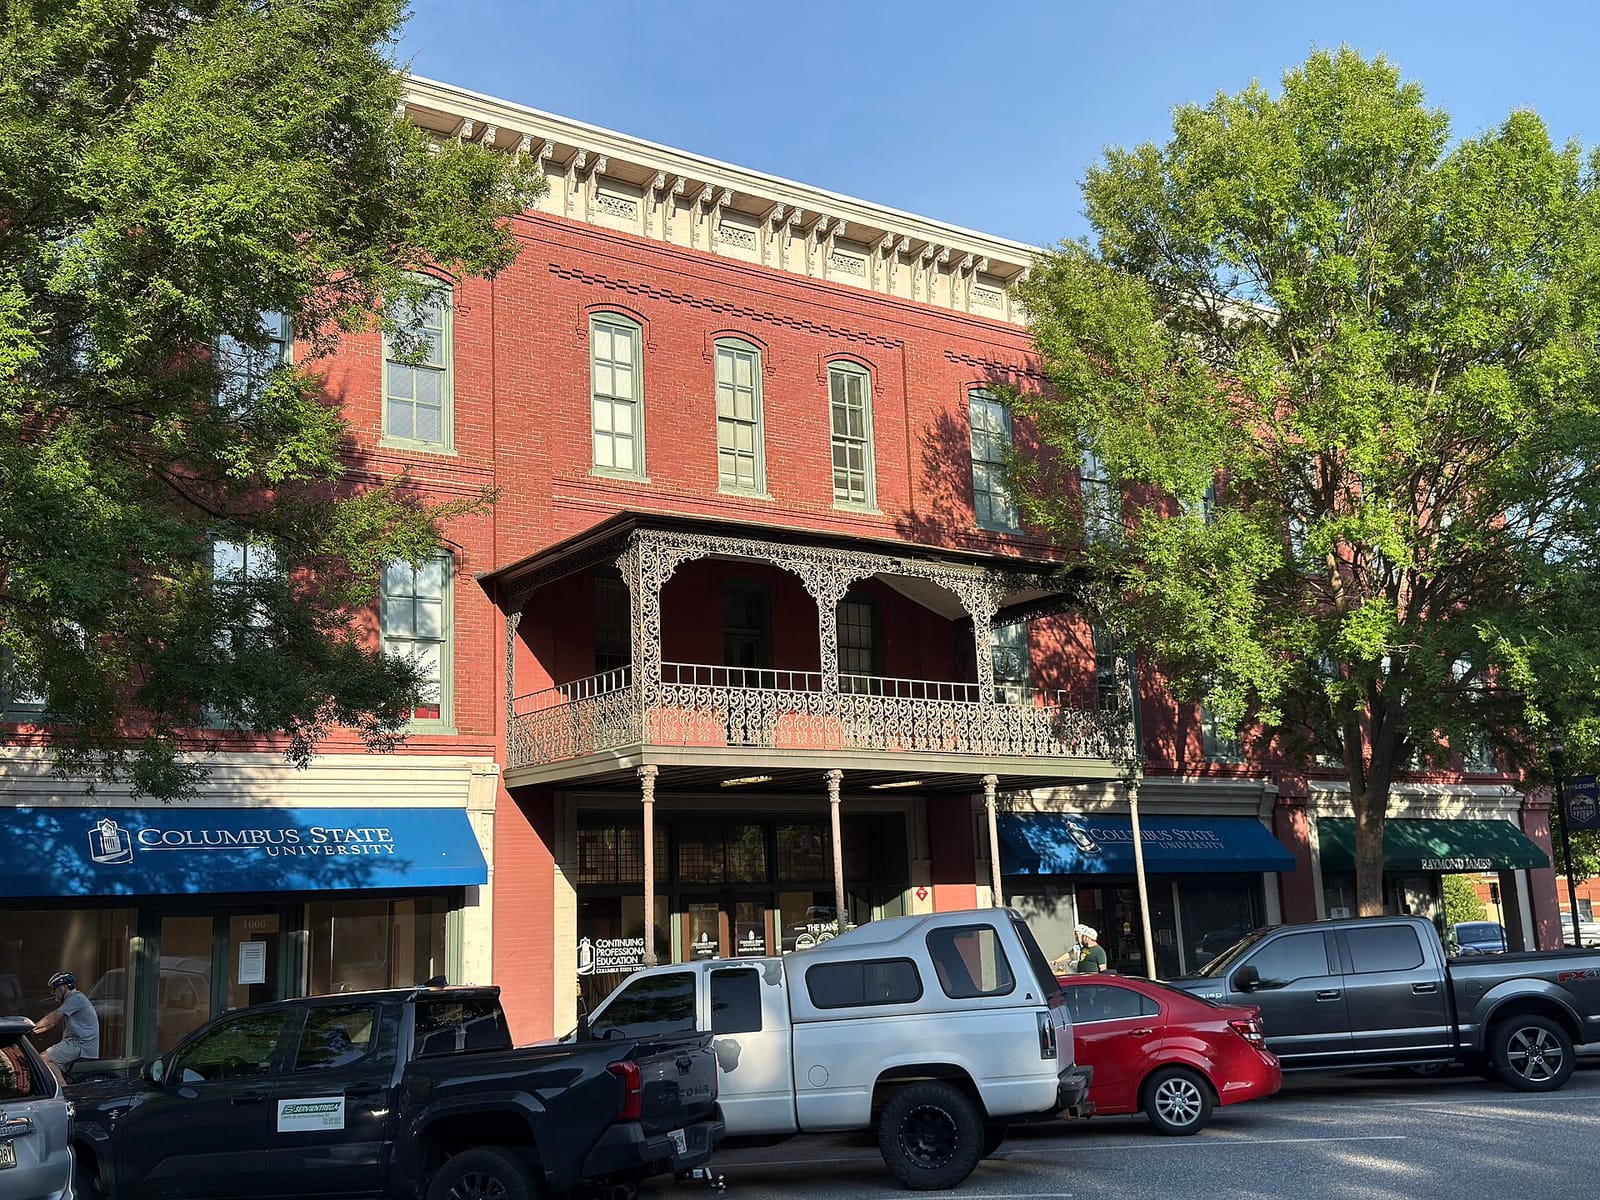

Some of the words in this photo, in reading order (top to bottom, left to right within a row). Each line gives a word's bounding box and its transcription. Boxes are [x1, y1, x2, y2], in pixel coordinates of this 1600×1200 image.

[138, 828, 301, 846] COLUMBUS
[310, 826, 394, 844] STATE
[1172, 828, 1220, 841] STATE
[266, 843, 395, 857] UNIVERSITY
[1158, 841, 1225, 849] UNIVERSITY
[1421, 858, 1464, 869] RAYMOND
[1465, 857, 1492, 869] JAMES
[242, 919, 266, 929] 1006
[806, 923, 820, 932] THE
[595, 938, 644, 948] CONTINUING
[596, 947, 645, 957] PROFESSIONA
[596, 956, 638, 966] EDUCATION
